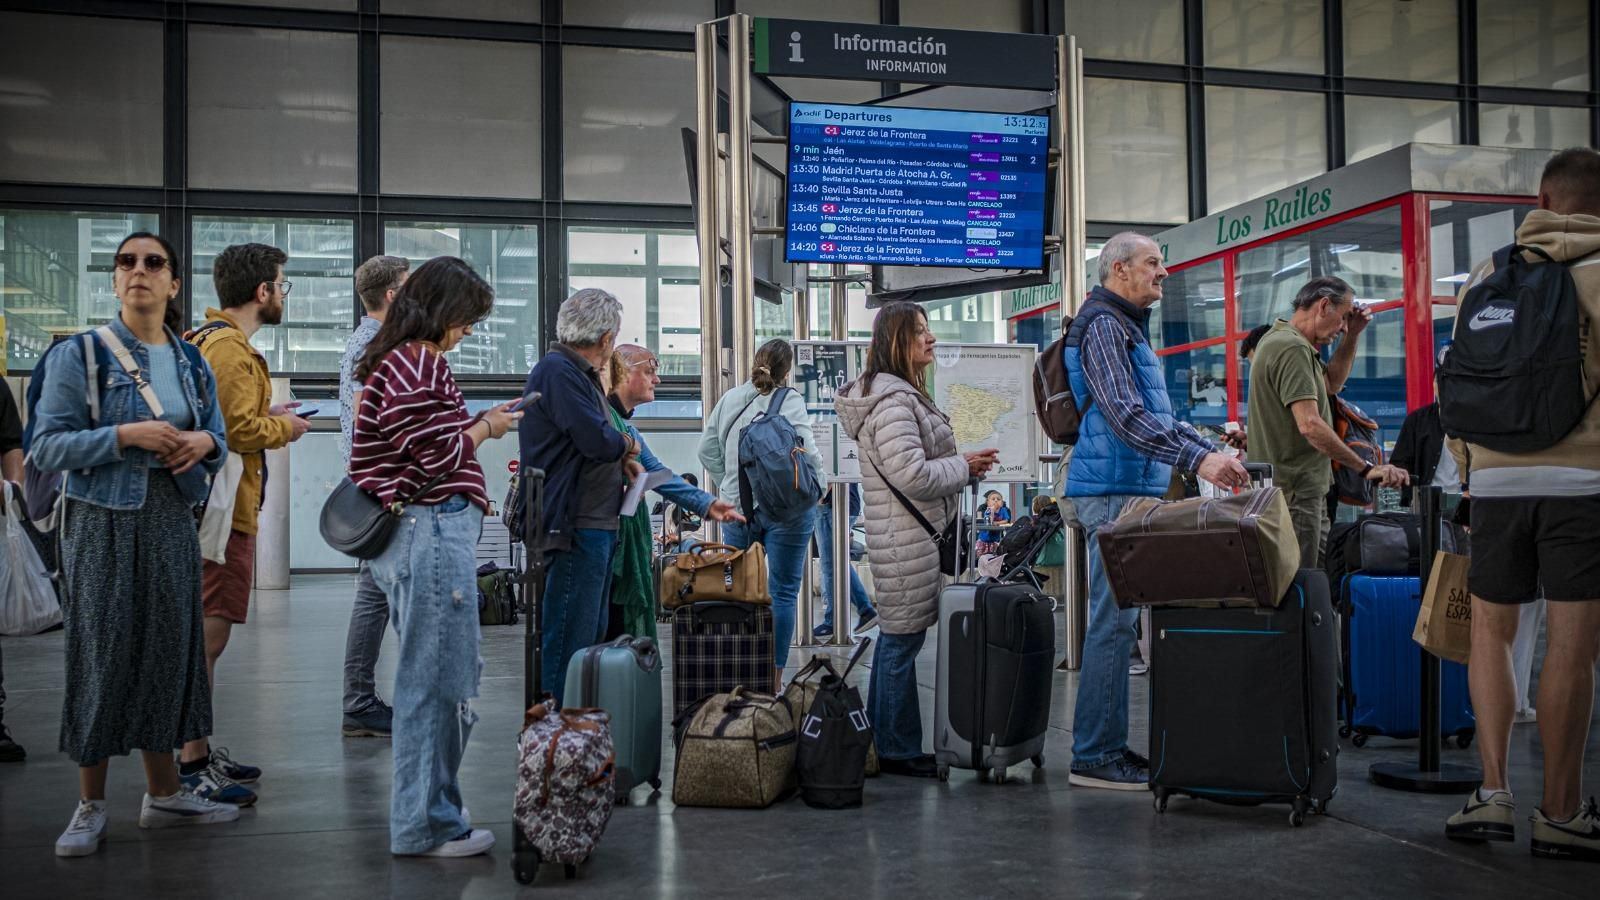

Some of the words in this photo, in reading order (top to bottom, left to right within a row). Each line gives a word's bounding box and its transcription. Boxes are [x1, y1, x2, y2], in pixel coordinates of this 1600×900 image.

[833, 33, 947, 56] Información
[866, 59, 946, 75] INFORMATION
[825, 110, 892, 122] Departures
[841, 128, 865, 137] Jerez
[868, 129, 878, 137] de
[880, 130, 888, 138] la
[890, 130, 926, 140] Frontera
[803, 146, 819, 154] min
[823, 146, 844, 155] Jaén
[1030, 156, 1036, 164] 2
[793, 165, 819, 173] 13:30
[822, 166, 852, 175] Madrid
[855, 167, 882, 176] Puerta
[885, 168, 896, 176] de
[898, 168, 927, 178] Atocha
[930, 171, 938, 179] A.
[793, 184, 818, 192] 13:40
[822, 186, 850, 194] Sevilla
[852, 187, 877, 196] Santa
[792, 204, 818, 212] 13:45
[888, 208, 924, 216] Frontera
[1216, 211, 1252, 246] Los
[1263, 186, 1332, 231] Railes
[792, 224, 817, 232] 14:06
[838, 225, 875, 233] Chiclana
[791, 243, 816, 251] 14:20
[837, 244, 861, 253] Jerez
[886, 246, 922, 254] Frontera
